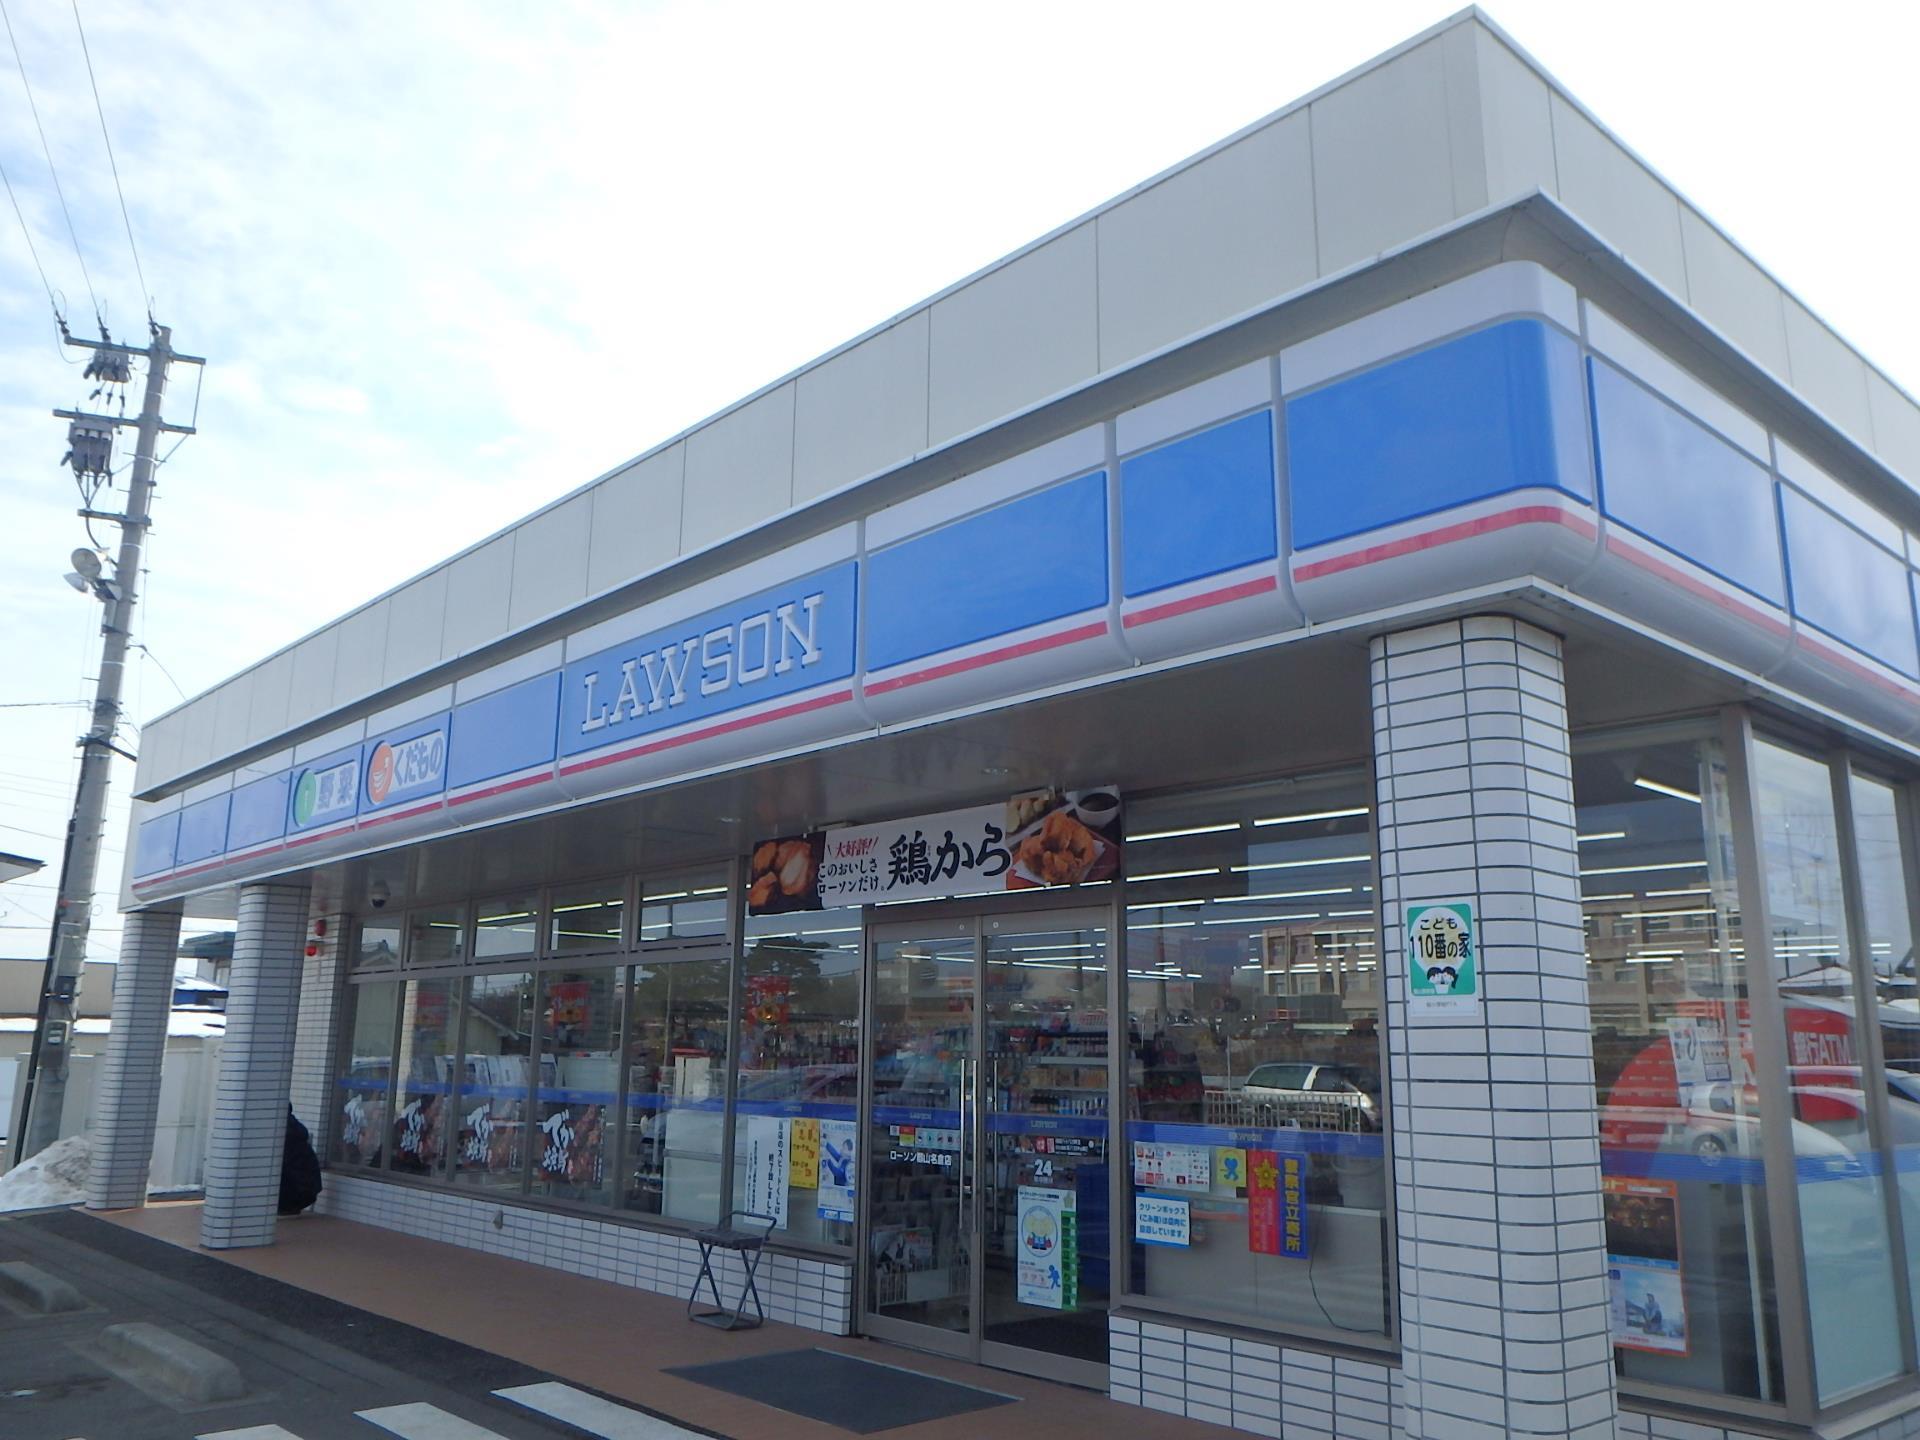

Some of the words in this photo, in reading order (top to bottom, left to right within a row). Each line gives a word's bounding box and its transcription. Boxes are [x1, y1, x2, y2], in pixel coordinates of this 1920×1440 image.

[582, 592, 824, 734] LAWSON
[395, 737, 443, 785] くだもの
[317, 766, 354, 809] 野菜
[819, 858, 877, 879] このおいしさ
[887, 822, 1011, 891] 鶏から
[1420, 918, 1458, 930] こども
[1409, 932, 1471, 959] 110番の家
[1034, 1159, 1053, 1178] 24
